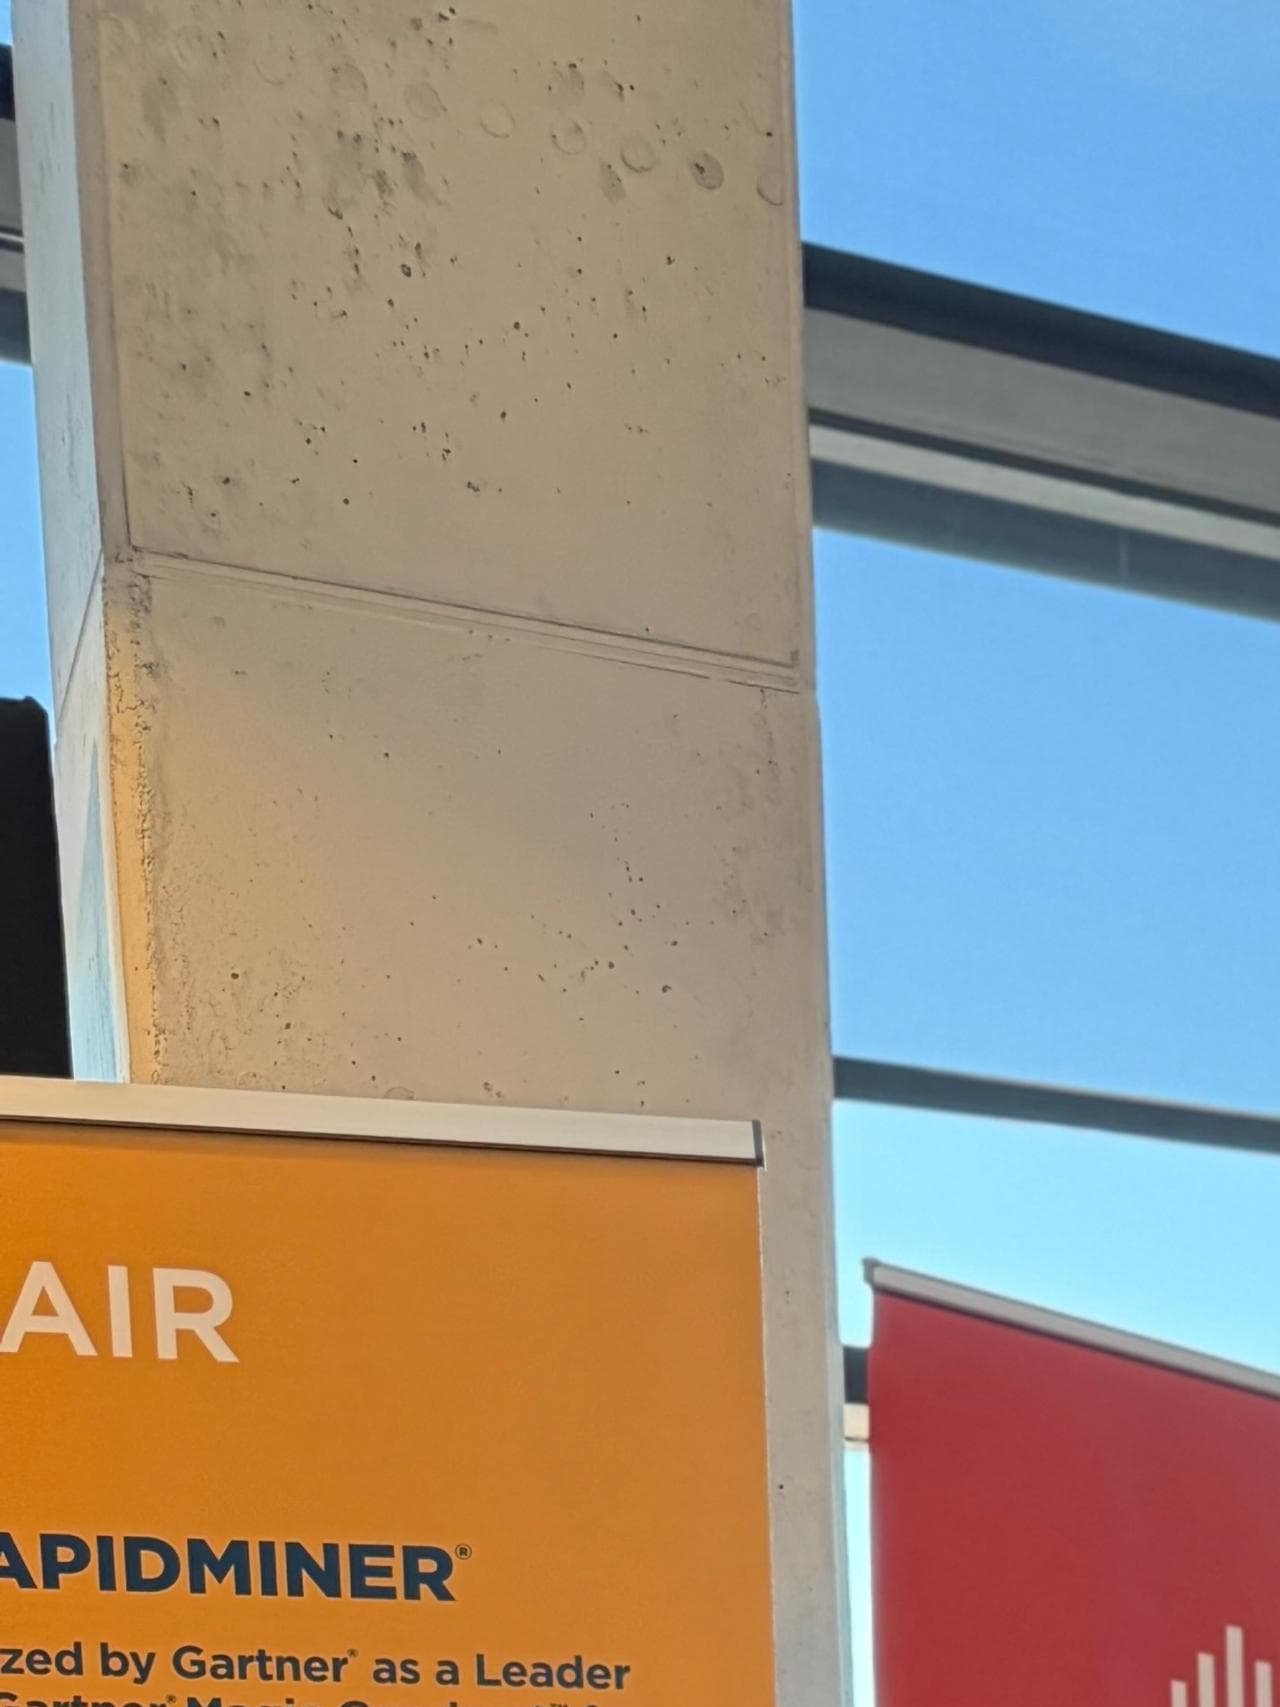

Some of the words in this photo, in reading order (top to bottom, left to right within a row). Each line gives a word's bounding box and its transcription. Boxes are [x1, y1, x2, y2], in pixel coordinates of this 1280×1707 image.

[0, 1261, 240, 1363] AIR
[0, 1641, 84, 1677] zed
[100, 1642, 156, 1685] by
[373, 1656, 421, 1684] as
[436, 1659, 460, 1686] a
[476, 1653, 631, 1689] Leader
